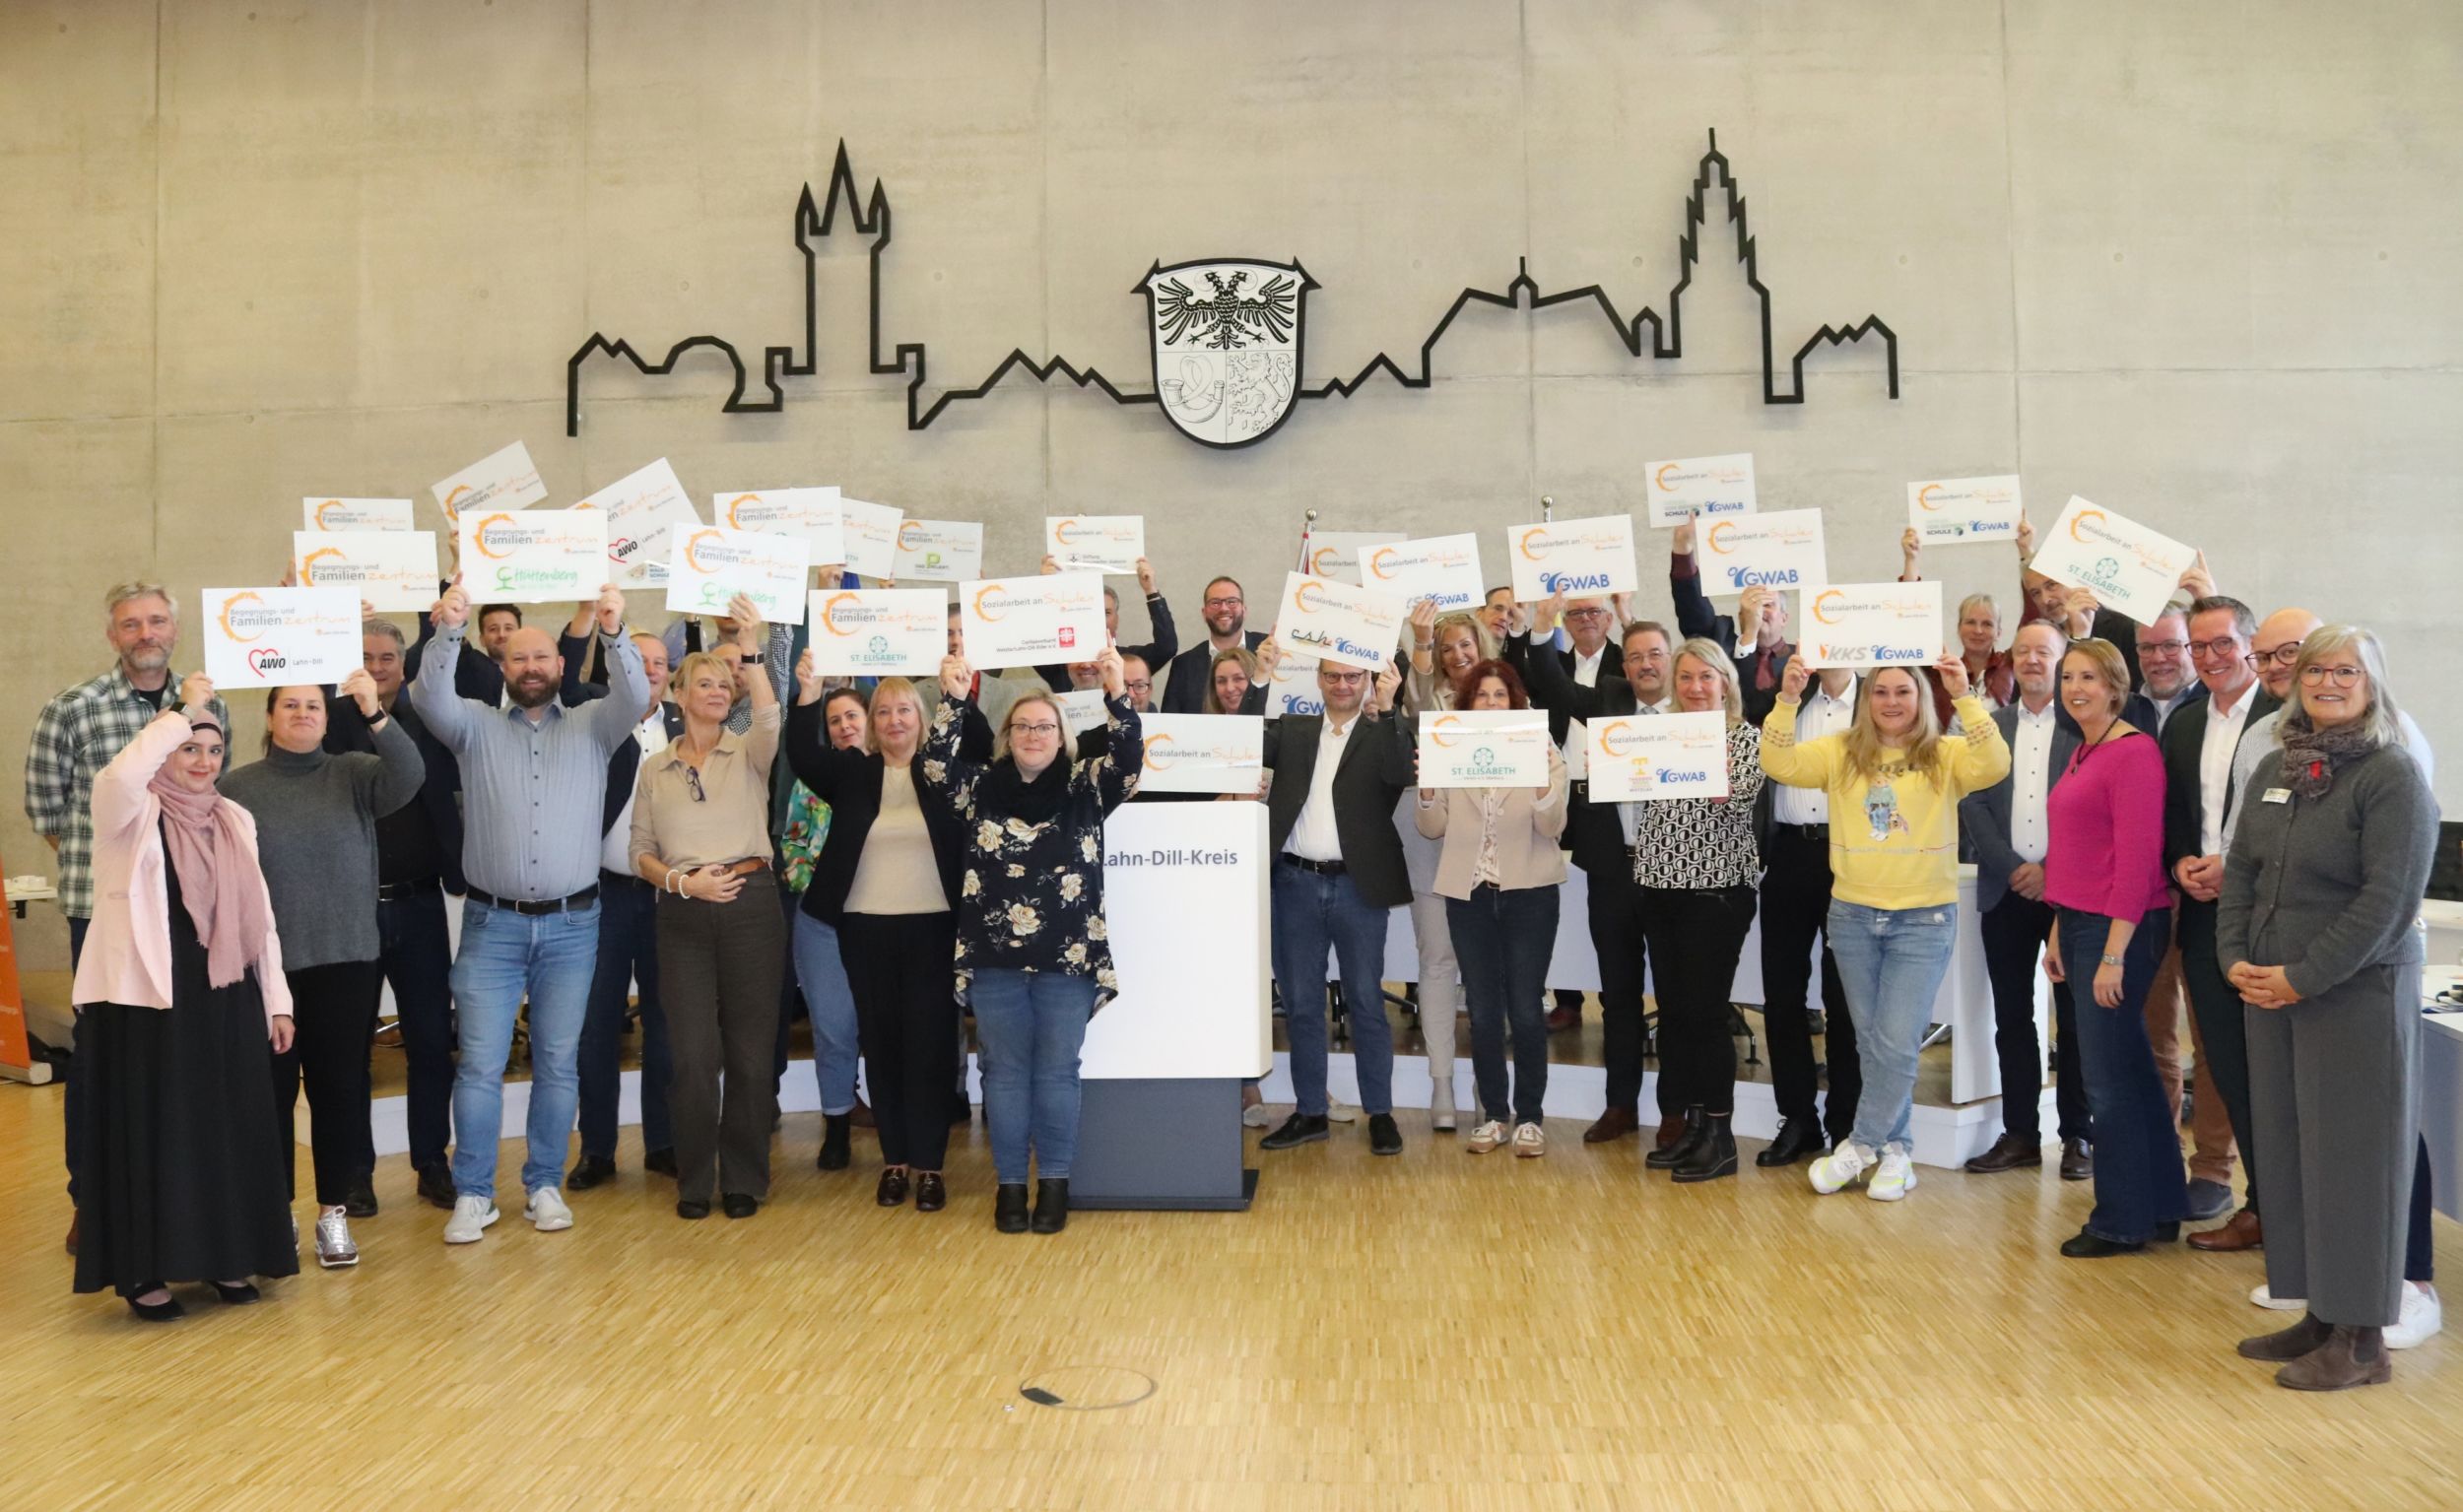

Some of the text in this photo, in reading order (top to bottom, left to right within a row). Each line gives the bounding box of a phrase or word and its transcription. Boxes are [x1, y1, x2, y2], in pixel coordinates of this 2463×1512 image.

[1714, 502, 1745, 511] GWAB
[736, 512, 778, 522] Familien
[1978, 521, 2011, 532] GWAB
[484, 535, 533, 545] Familien
[1715, 533, 1759, 543] Sozialarbeit
[2078, 520, 2122, 545] Sozialarbeit
[2122, 541, 2133, 551] an
[617, 541, 638, 559] AWO
[1527, 539, 1569, 550] Sozialarbeit
[694, 549, 739, 563] Familien
[1378, 558, 1419, 569] Sozialarbeit
[311, 570, 366, 581] Familien
[1744, 568, 1799, 586] GWAB
[1557, 573, 1611, 592] GWAB
[2067, 564, 2081, 577] ST.
[2081, 571, 2132, 600] ELISABETH
[981, 598, 1032, 609] Sozialarbeit
[1301, 592, 1343, 609] Sozialarbeit
[1435, 593, 1470, 606] GWAB
[230, 608, 279, 617] Begegnungs-
[1821, 604, 1869, 613] Sozialarbeit
[230, 615, 283, 627] Familien
[832, 613, 877, 623] Familien
[1344, 644, 1380, 662] GWAB
[1883, 648, 1924, 661] GWAB
[259, 657, 324, 670] AWO Lahn-Dill
[1608, 734, 1655, 745] Sozialarbeit
[1149, 749, 1198, 757] Sozialarbeit
[1667, 771, 1707, 783] GWAB
[1103, 848, 1238, 867] ahn-Dill-Kreis
